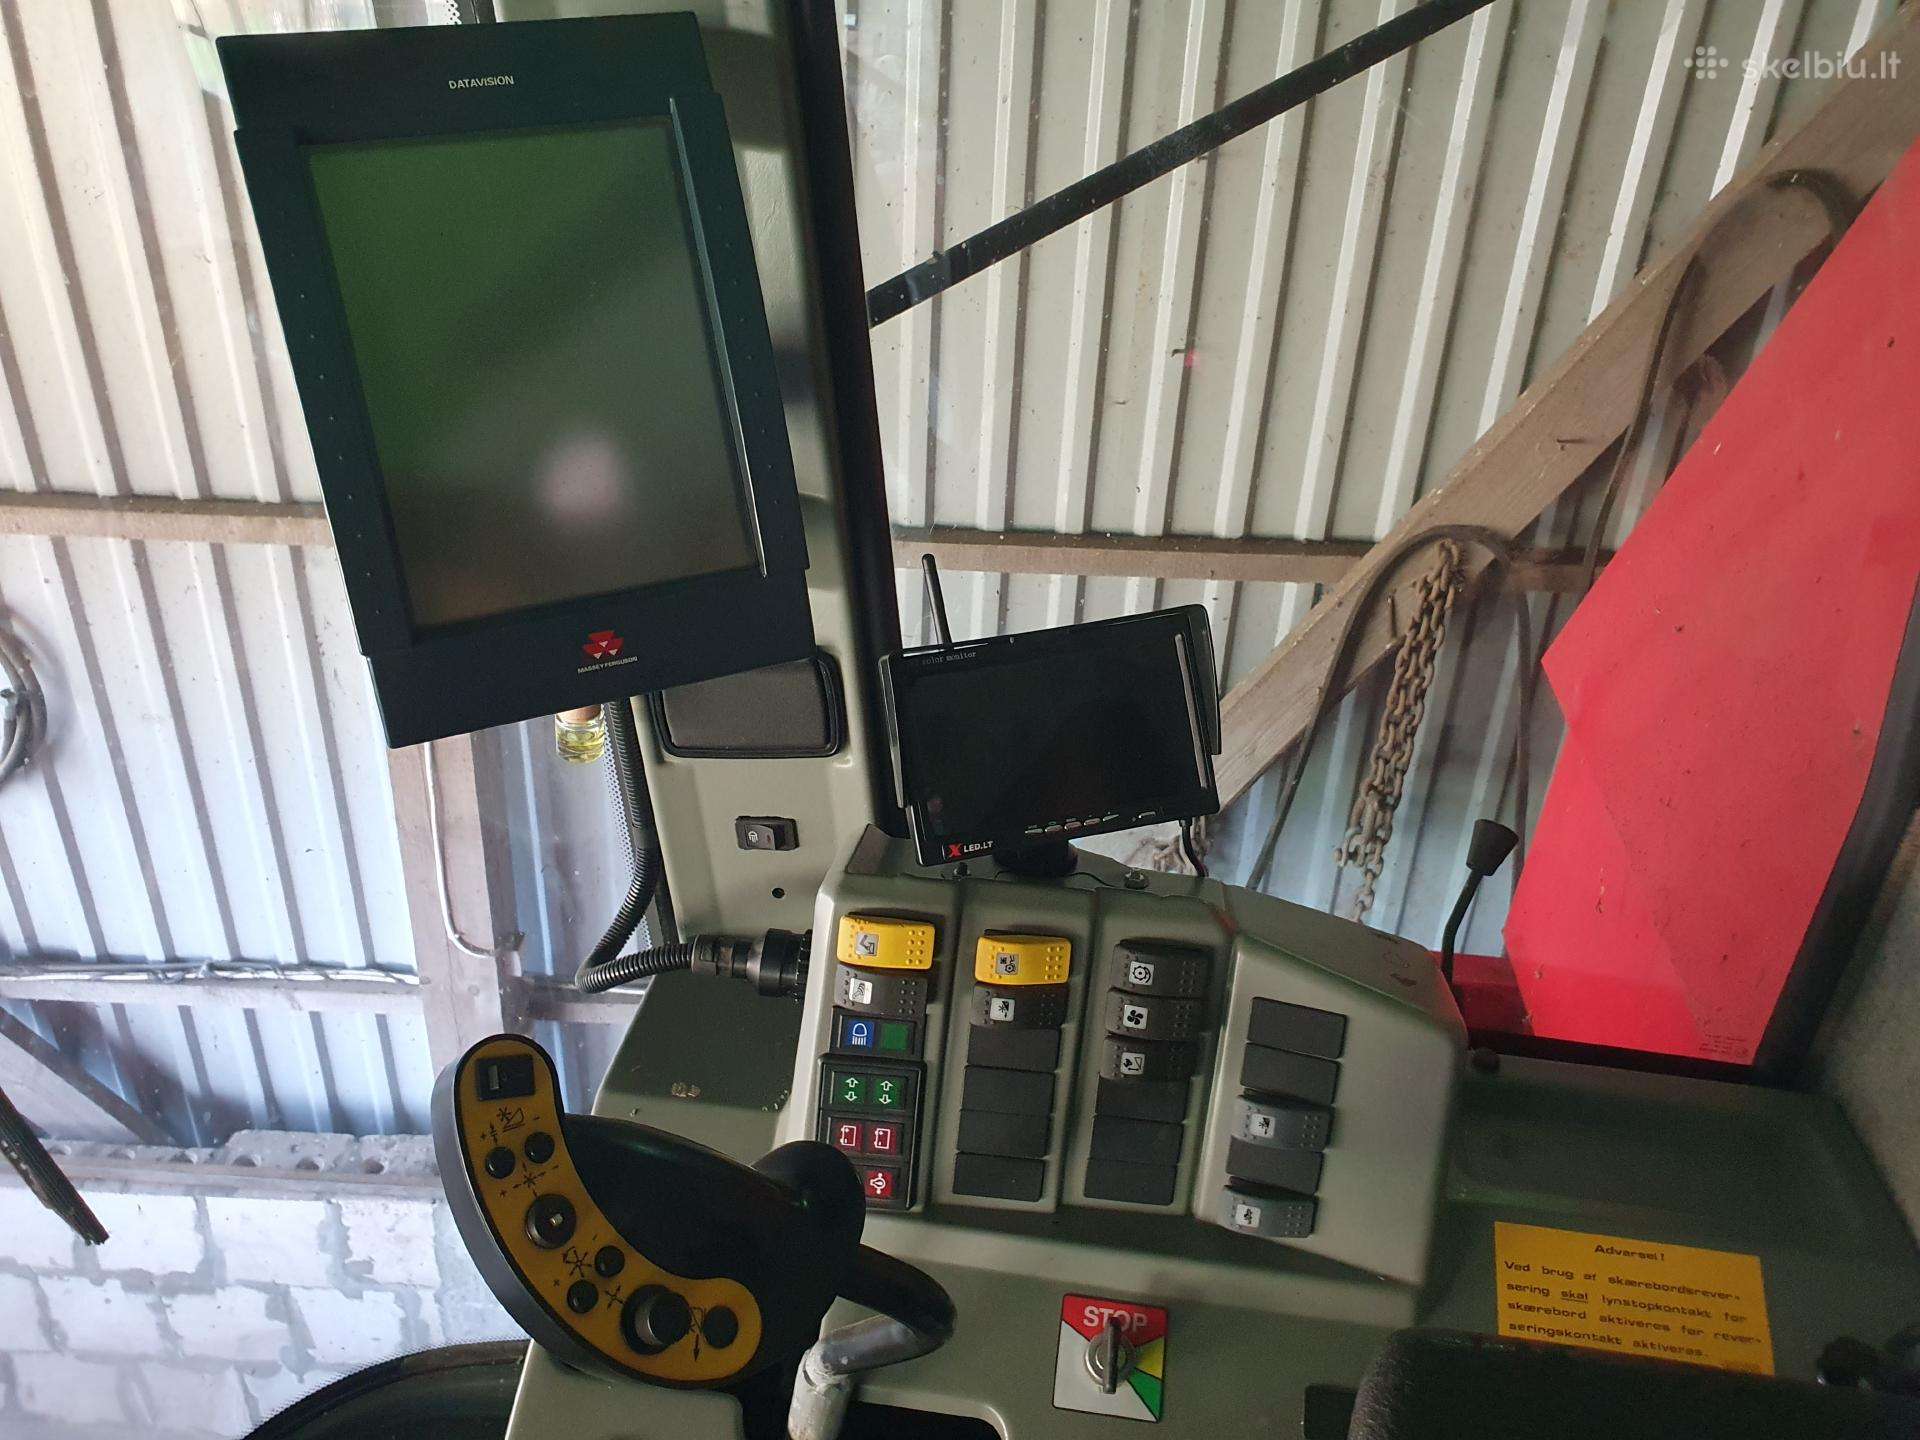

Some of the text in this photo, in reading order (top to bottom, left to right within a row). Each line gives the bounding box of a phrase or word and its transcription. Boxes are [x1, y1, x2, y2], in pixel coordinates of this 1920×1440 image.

[448, 75, 515, 90] DATAVISION
[946, 651, 977, 662] monitor
[1504, 1260, 1531, 1273] Ved
[1541, 1265, 1575, 1280] brug
[1583, 1272, 1597, 1282] af
[1506, 1282, 1551, 1298] sering
[1560, 1289, 1589, 1302] skal
[1601, 1294, 1713, 1319] lynstopkontakt
[1083, 1305, 1148, 1333] STOP
[1507, 1301, 1587, 1320] skærebord
[1599, 1313, 1671, 1332] aktiveres
[1508, 1322, 1623, 1346] seringskontakt
